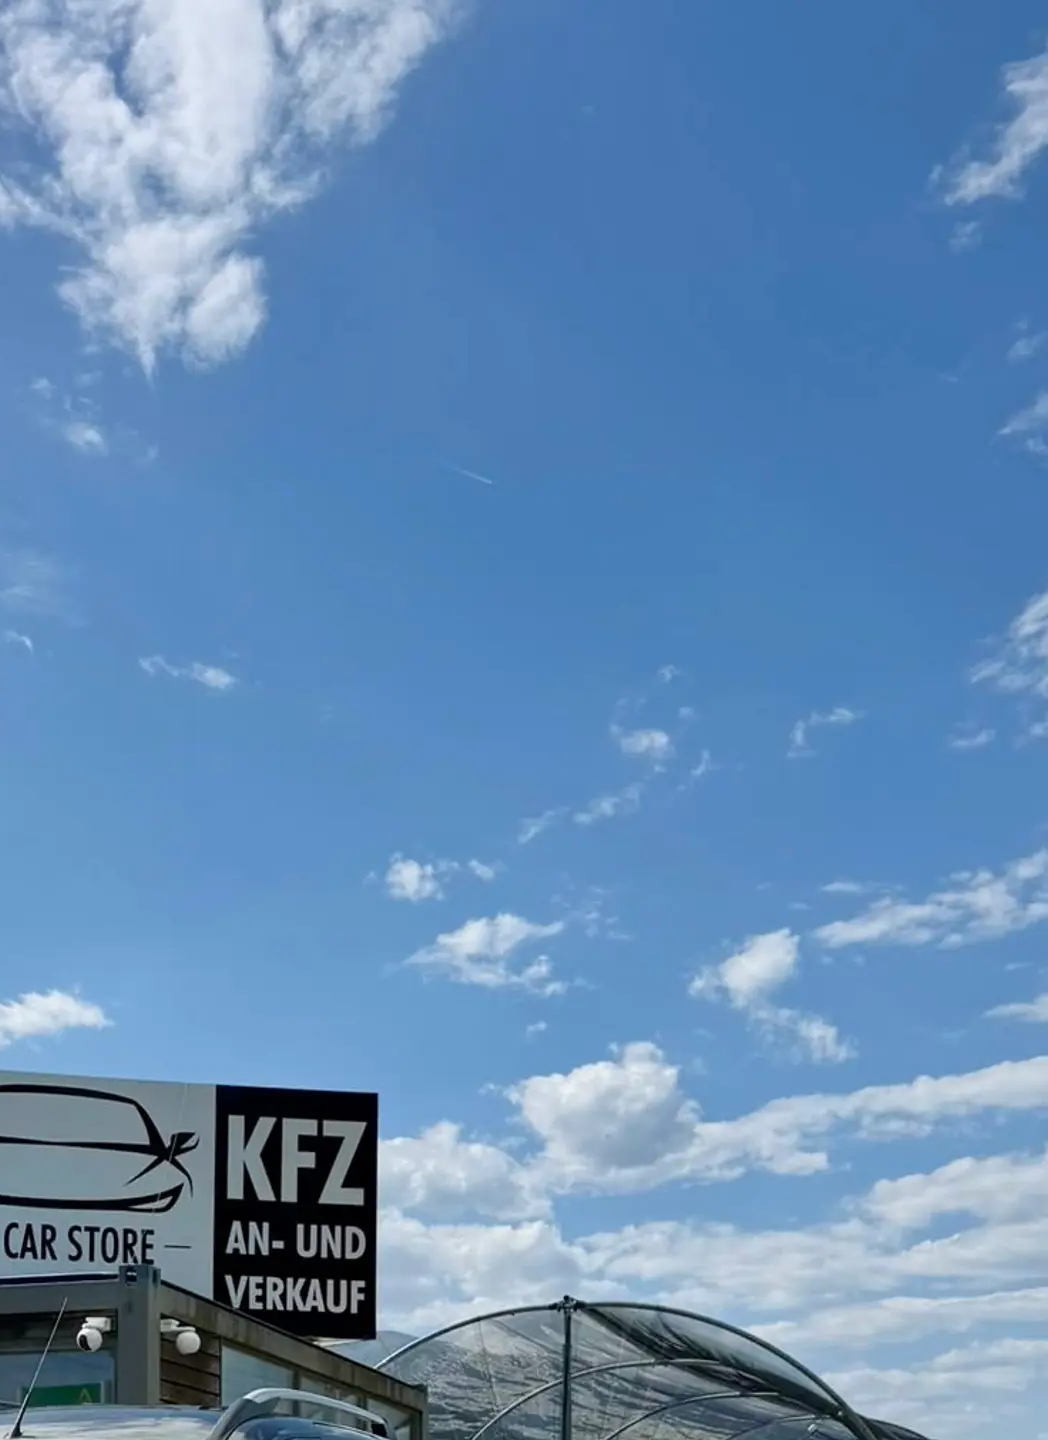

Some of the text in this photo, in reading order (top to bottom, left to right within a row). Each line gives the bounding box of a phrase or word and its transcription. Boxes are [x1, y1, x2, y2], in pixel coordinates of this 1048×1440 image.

[226, 1114, 368, 1207] KFZ
[3, 1221, 58, 1261] CAR
[67, 1224, 156, 1265] STORE
[225, 1220, 367, 1261] AN- UND
[224, 1274, 366, 1314] VERKAUF
